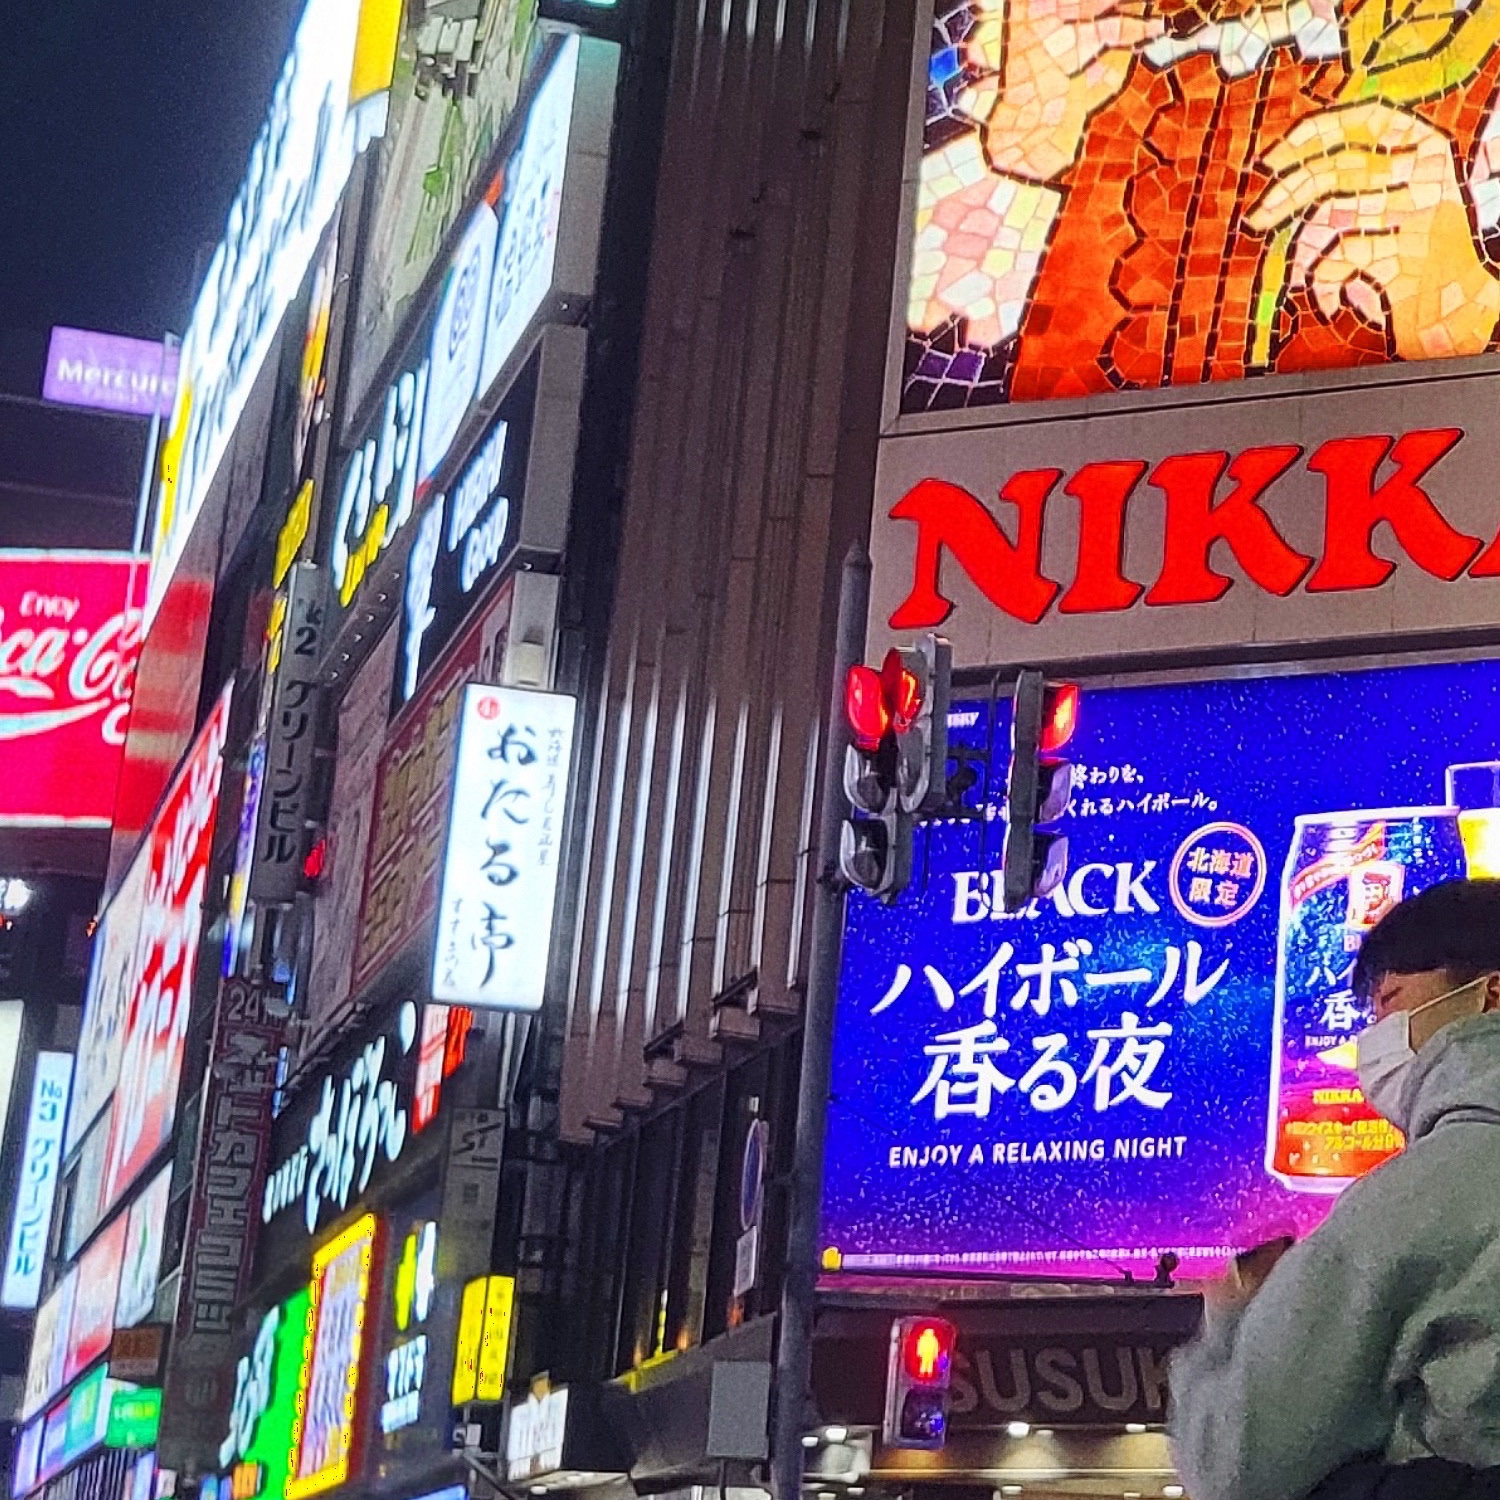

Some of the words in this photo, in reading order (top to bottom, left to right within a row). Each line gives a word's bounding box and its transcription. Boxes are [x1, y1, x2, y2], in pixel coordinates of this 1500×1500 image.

[1187, 846, 1255, 880] 北海道
[1188, 876, 1240, 909] 限定
[869, 938, 1230, 1018] ハイボール
[910, 1011, 1174, 1120] 香る夜
[889, 1145, 962, 1169] ENJOY
[968, 1145, 985, 1164] A
[992, 1138, 1105, 1164] RELAXING
[1113, 1135, 1188, 1159] NIGHT
